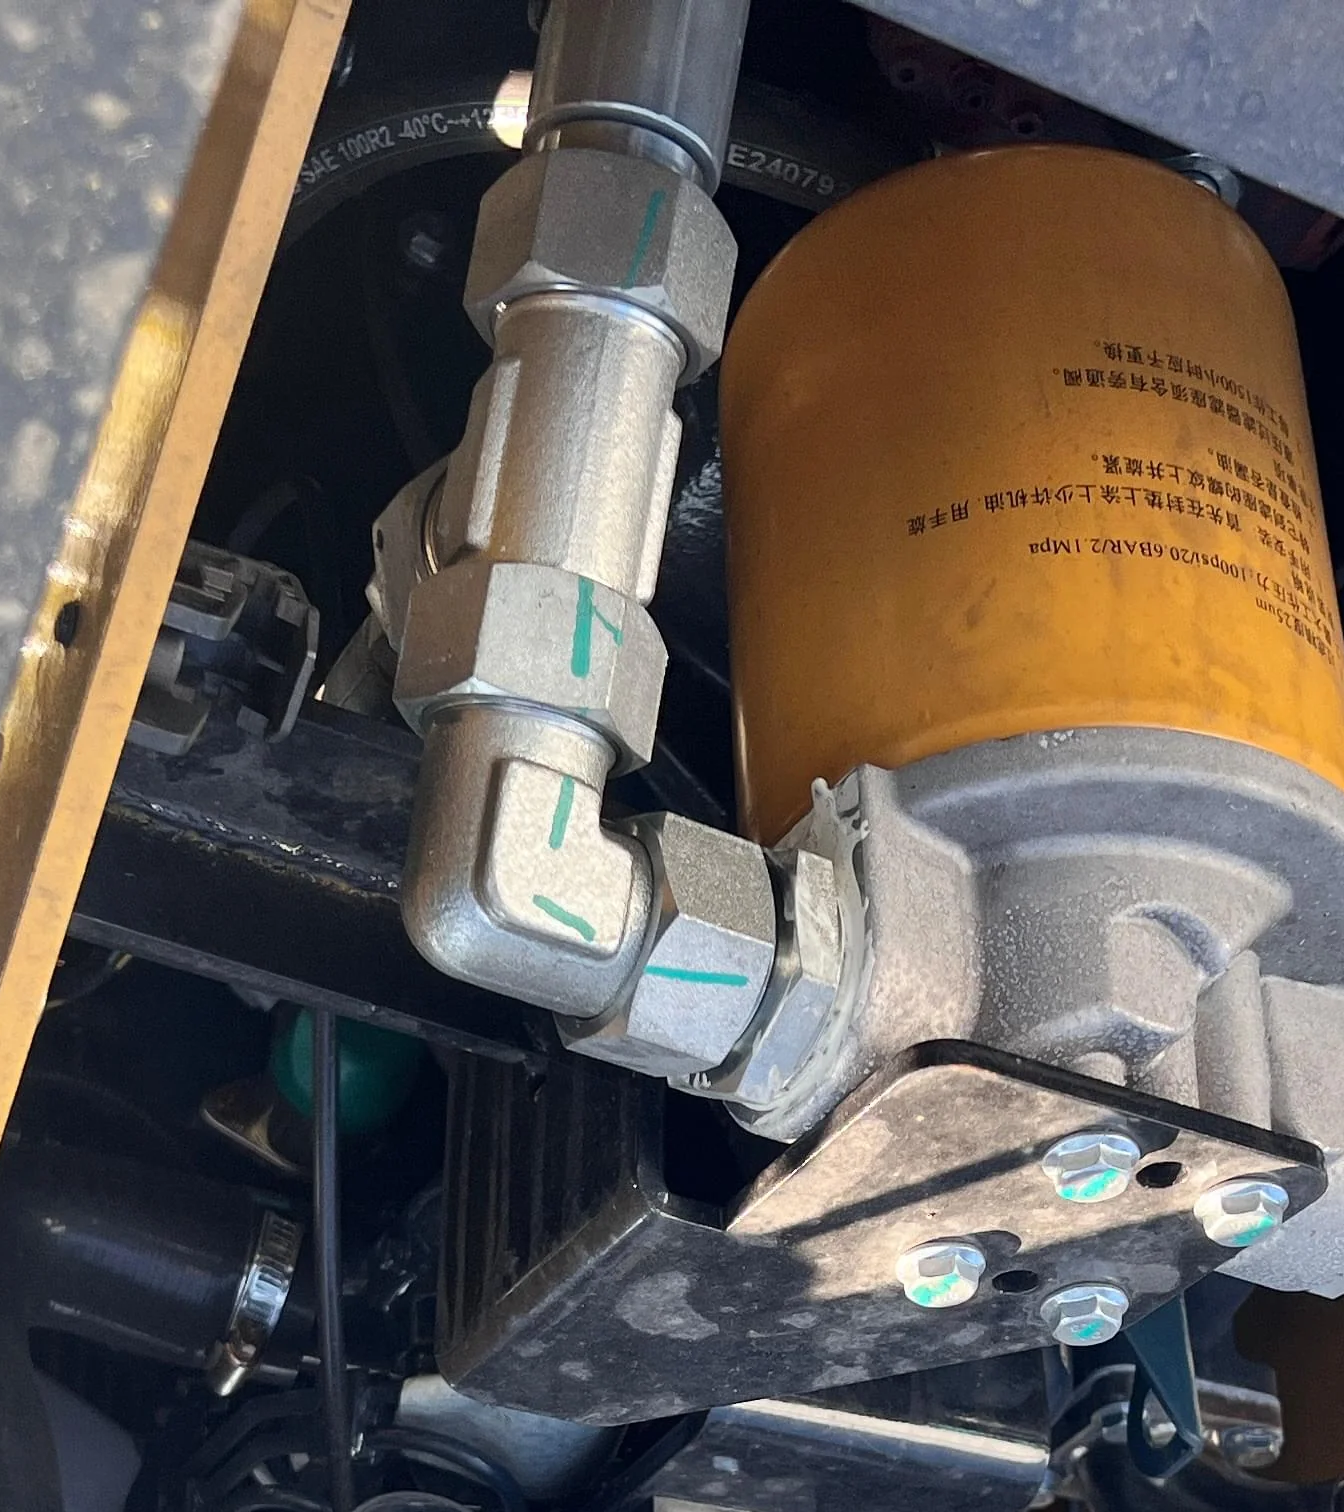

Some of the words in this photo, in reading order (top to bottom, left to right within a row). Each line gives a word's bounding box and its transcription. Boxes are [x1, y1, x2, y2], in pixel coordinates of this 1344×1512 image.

[300, 149, 340, 184] SAE
[337, 125, 396, 163] 100R2
[726, 142, 848, 202] E24079
